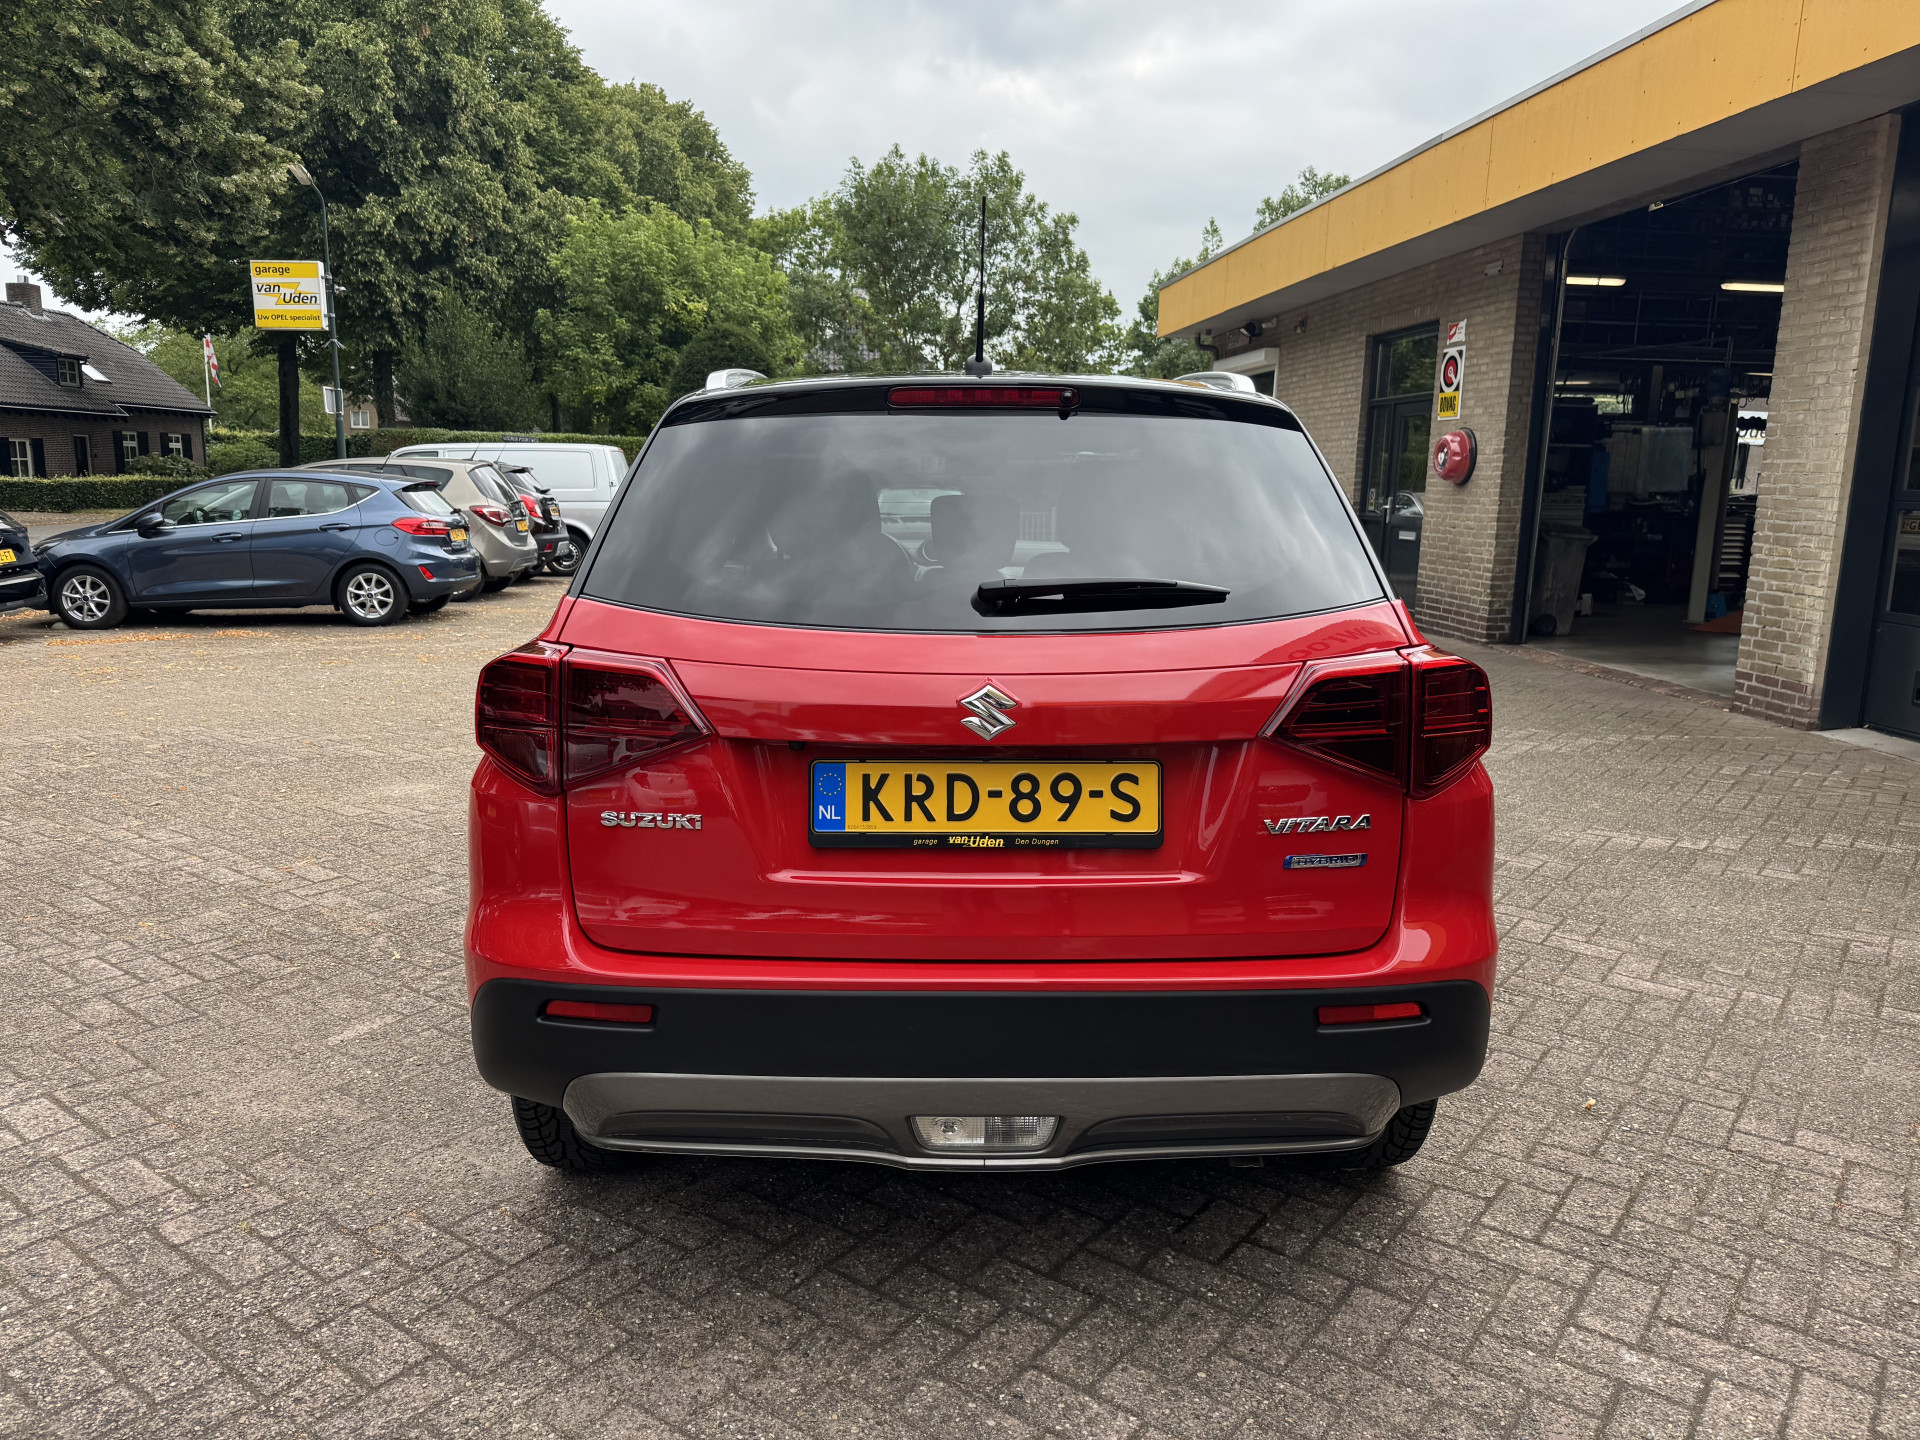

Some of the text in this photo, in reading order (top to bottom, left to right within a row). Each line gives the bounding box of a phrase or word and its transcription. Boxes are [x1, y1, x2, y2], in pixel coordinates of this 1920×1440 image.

[255, 266, 290, 275] garage
[256, 284, 318, 304] van Uden
[1440, 396, 1457, 413] BOVAG
[861, 771, 1142, 823] KRD-89-S
[600, 810, 702, 830] SUZUKI
[818, 804, 842, 820] NL
[1263, 813, 1371, 834] VITARA
[913, 838, 938, 846] garage
[949, 835, 969, 844] van
[969, 835, 1004, 847] Uden
[1031, 838, 1059, 846] Dungen
[1293, 855, 1358, 866] HYBRID
